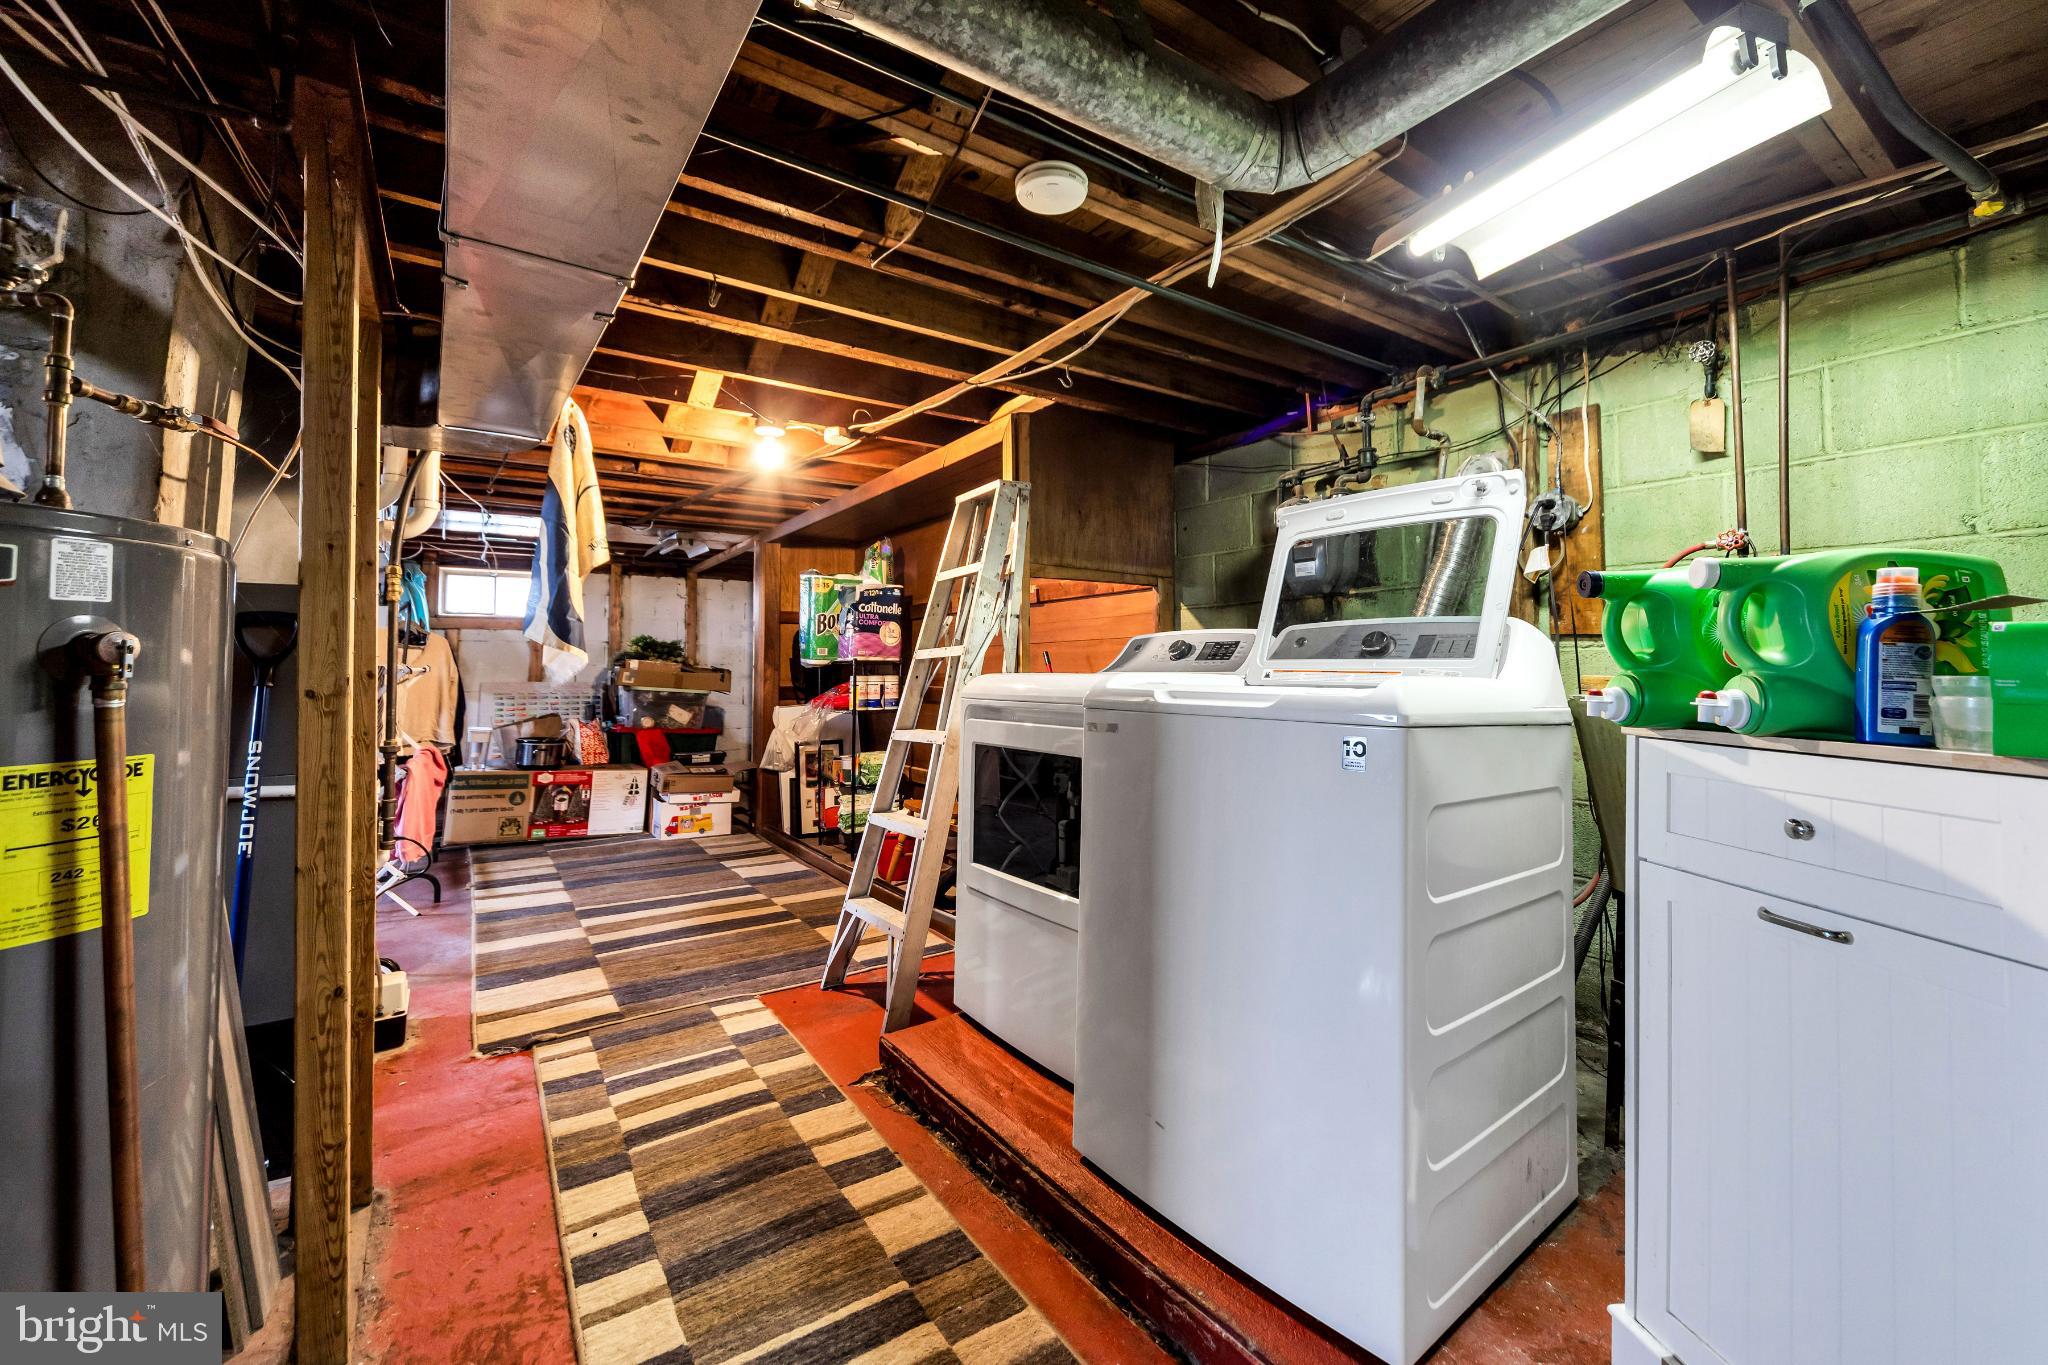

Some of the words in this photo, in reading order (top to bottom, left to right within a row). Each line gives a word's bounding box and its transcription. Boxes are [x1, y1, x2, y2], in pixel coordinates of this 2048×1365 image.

[858, 602, 902, 615] Cottonelle
[1343, 740, 1366, 757] 10
[50, 868, 84, 883] 242
